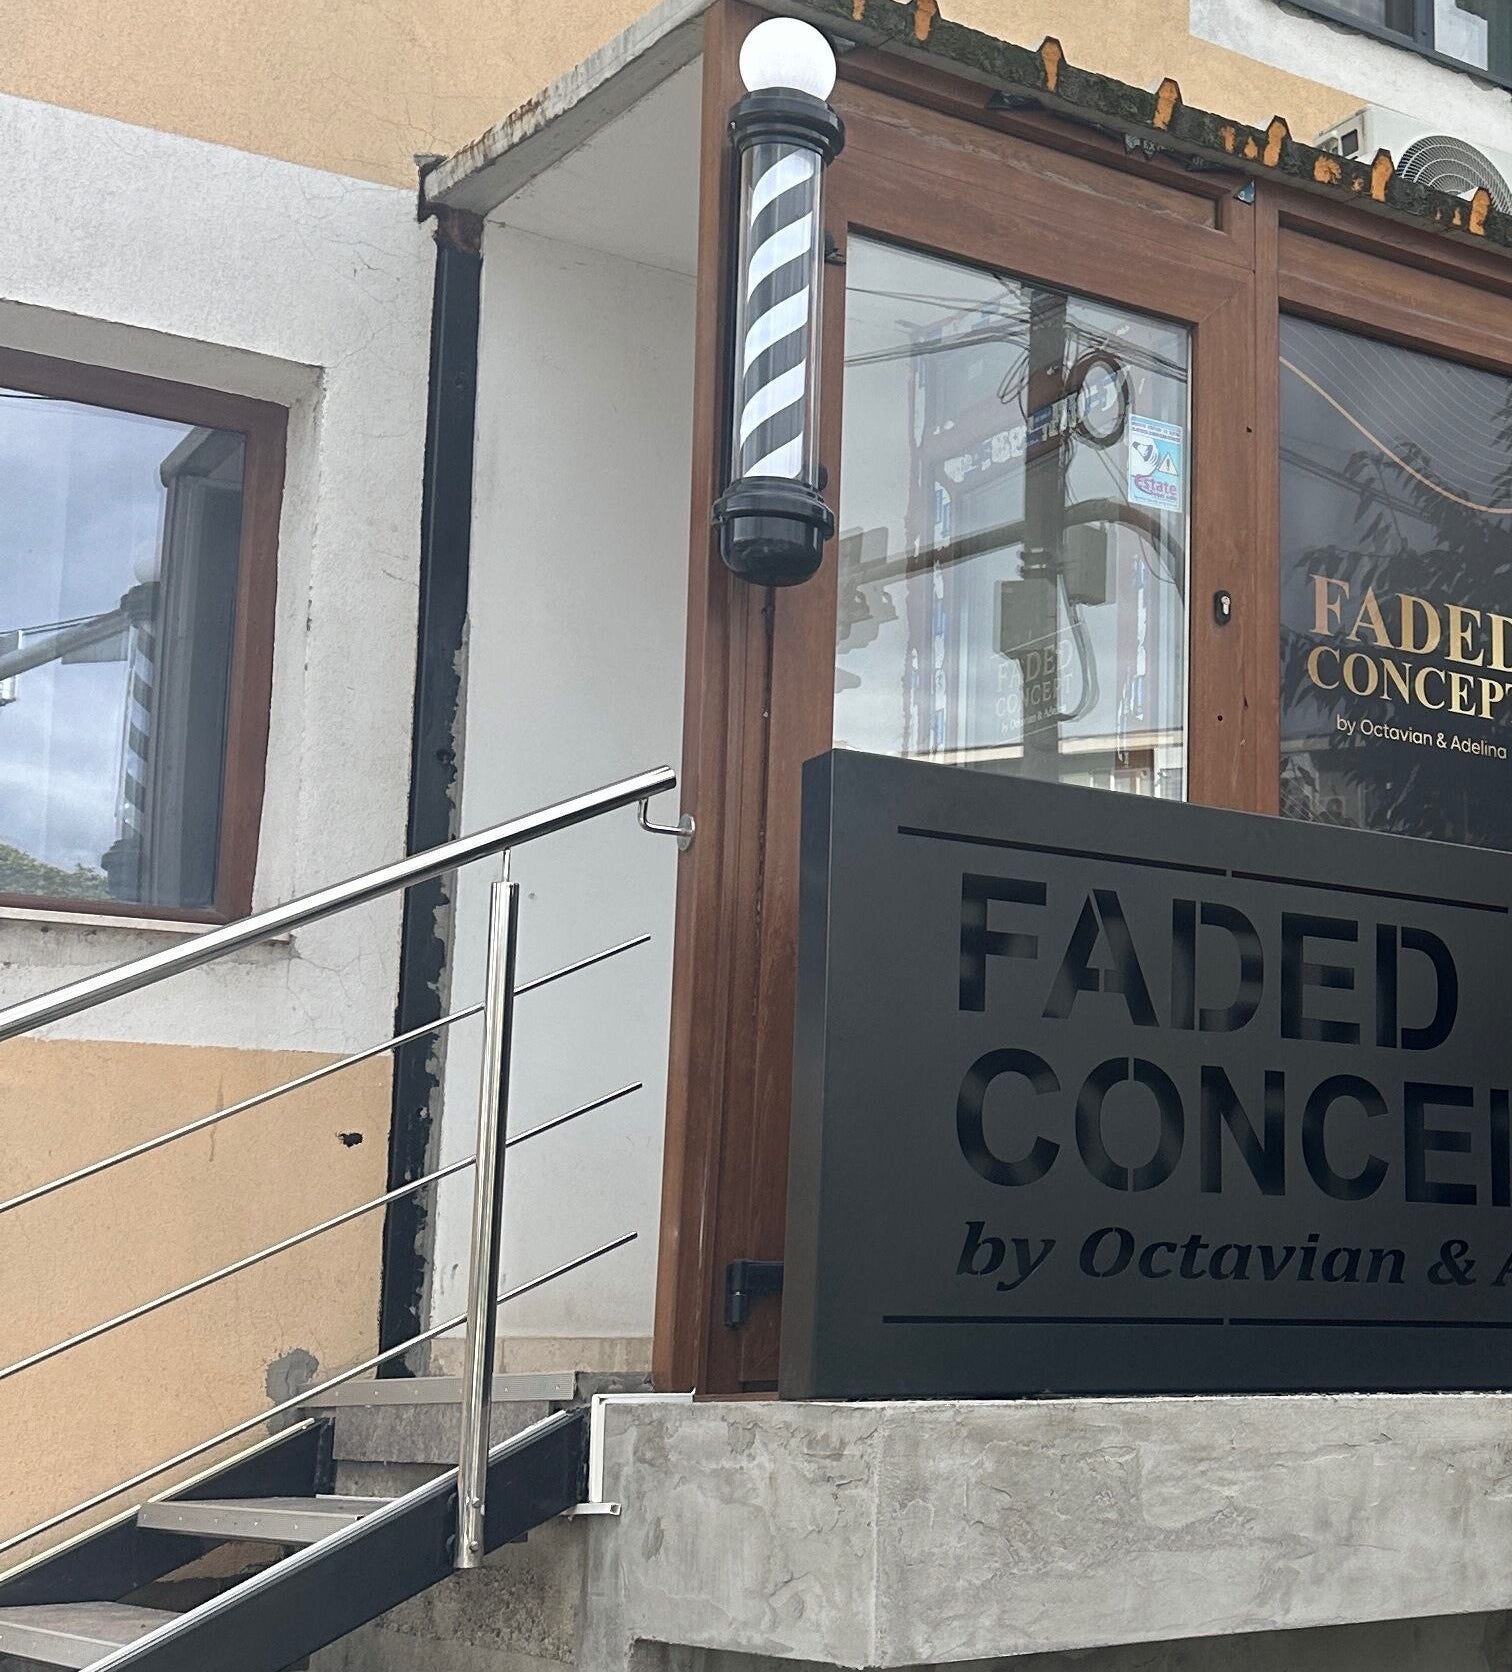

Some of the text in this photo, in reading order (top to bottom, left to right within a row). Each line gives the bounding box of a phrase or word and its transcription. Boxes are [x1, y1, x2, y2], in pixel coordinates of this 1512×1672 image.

[1336, 714, 1508, 760] by Octavian & Adelina
[958, 871, 1459, 1052] FADED
[955, 1220, 1057, 1292] by
[1079, 1226, 1405, 1285] Octavian
[1427, 1238, 1477, 1287] &
